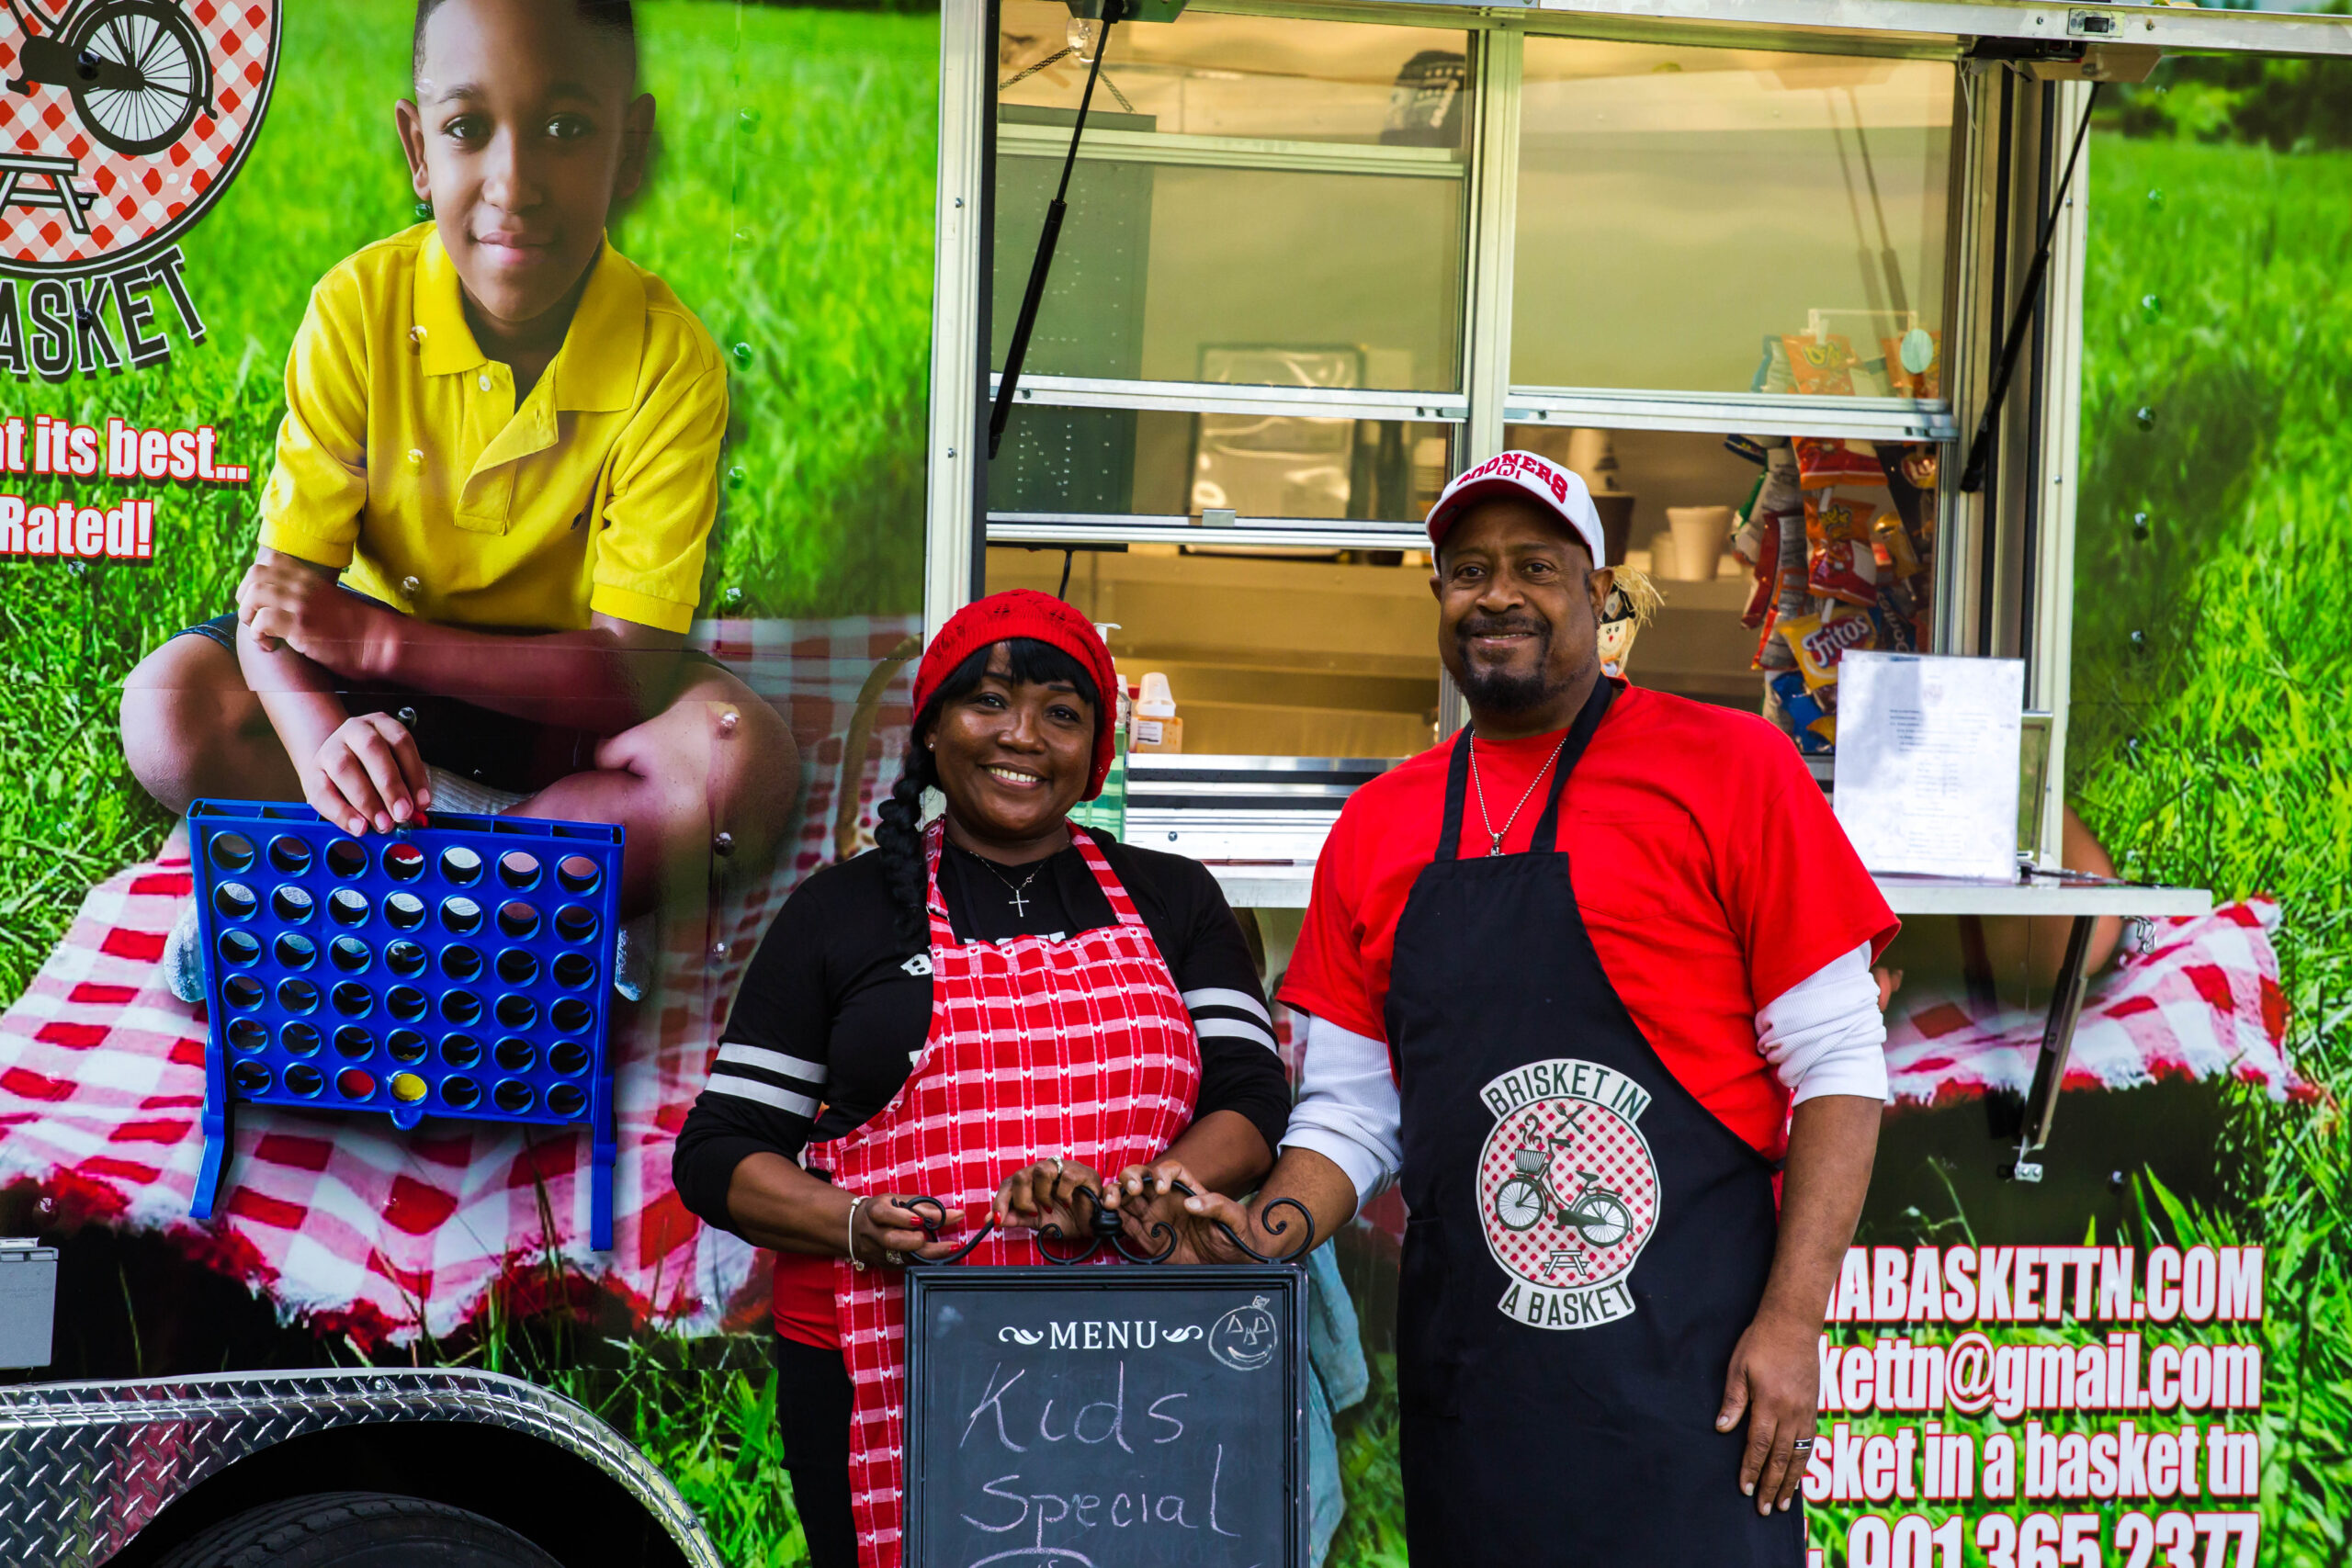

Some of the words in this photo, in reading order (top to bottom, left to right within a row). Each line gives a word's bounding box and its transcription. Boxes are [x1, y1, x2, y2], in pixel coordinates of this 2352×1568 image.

[0, 244, 207, 375] ASKET
[0, 415, 27, 474] t
[34, 414, 98, 477] its
[107, 417, 250, 482] best...
[0, 493, 154, 559] Rated!
[1802, 615, 1871, 669] Fritos
[1485, 1063, 1611, 1119] BRISKET
[1610, 1079, 1648, 1121] IN
[1048, 1320, 1159, 1350] MENU
[1501, 1283, 1522, 1316] A
[1527, 1279, 1633, 1325] BASKET
[960, 1359, 1189, 1454] Kids
[1924, 1421, 1975, 1500] in
[1982, 1432, 2018, 1500] a
[2024, 1420, 2201, 1498] basket
[2206, 1424, 2261, 1497] tn
[960, 1444, 1241, 1549] Special
